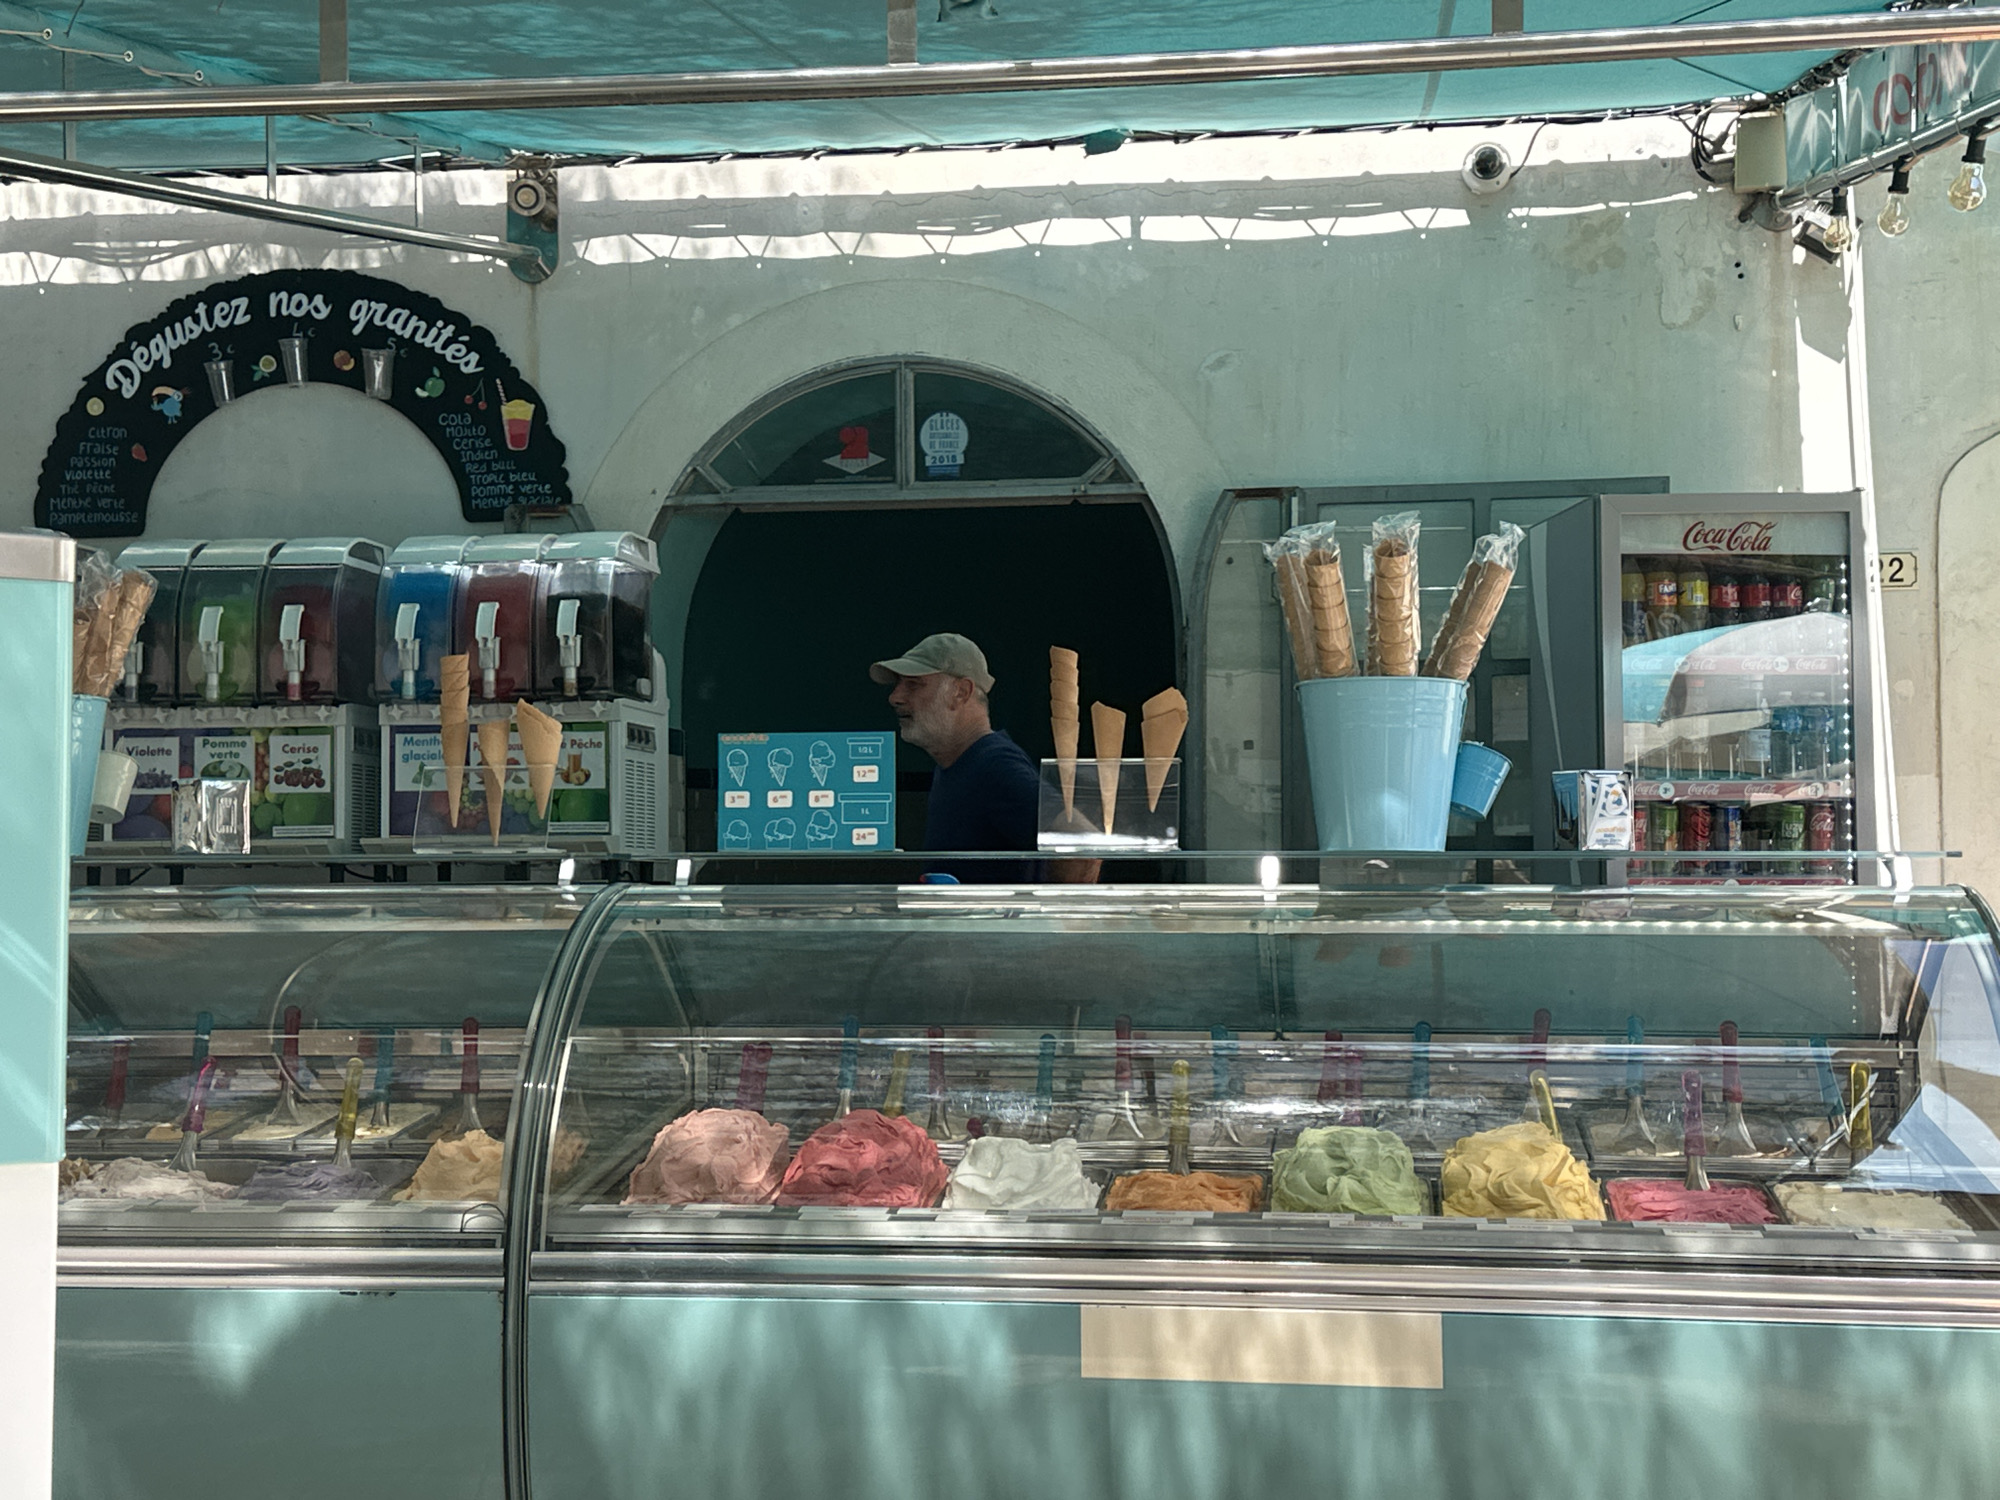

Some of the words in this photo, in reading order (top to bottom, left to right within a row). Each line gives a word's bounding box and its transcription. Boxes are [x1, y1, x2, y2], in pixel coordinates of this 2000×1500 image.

[105, 296, 251, 399] Dégustez
[269, 290, 333, 320] nos
[349, 299, 485, 374] granités
[929, 419, 960, 431] GLACES
[79, 442, 119, 455] Fraise
[453, 438, 493, 450] Cerise
[460, 449, 498, 462] Indien
[930, 454, 957, 465] 2018
[509, 471, 537, 482] bleu
[519, 483, 552, 494] verte
[1682, 520, 1779, 551] Coca-Cola
[202, 738, 248, 749] Pomme
[402, 736, 441, 747] Menth
[570, 738, 603, 749] Pêche
[126, 745, 173, 757] Violette
[281, 743, 319, 754] Cerise
[209, 751, 241, 760] verte
[402, 750, 443, 763] glacial
